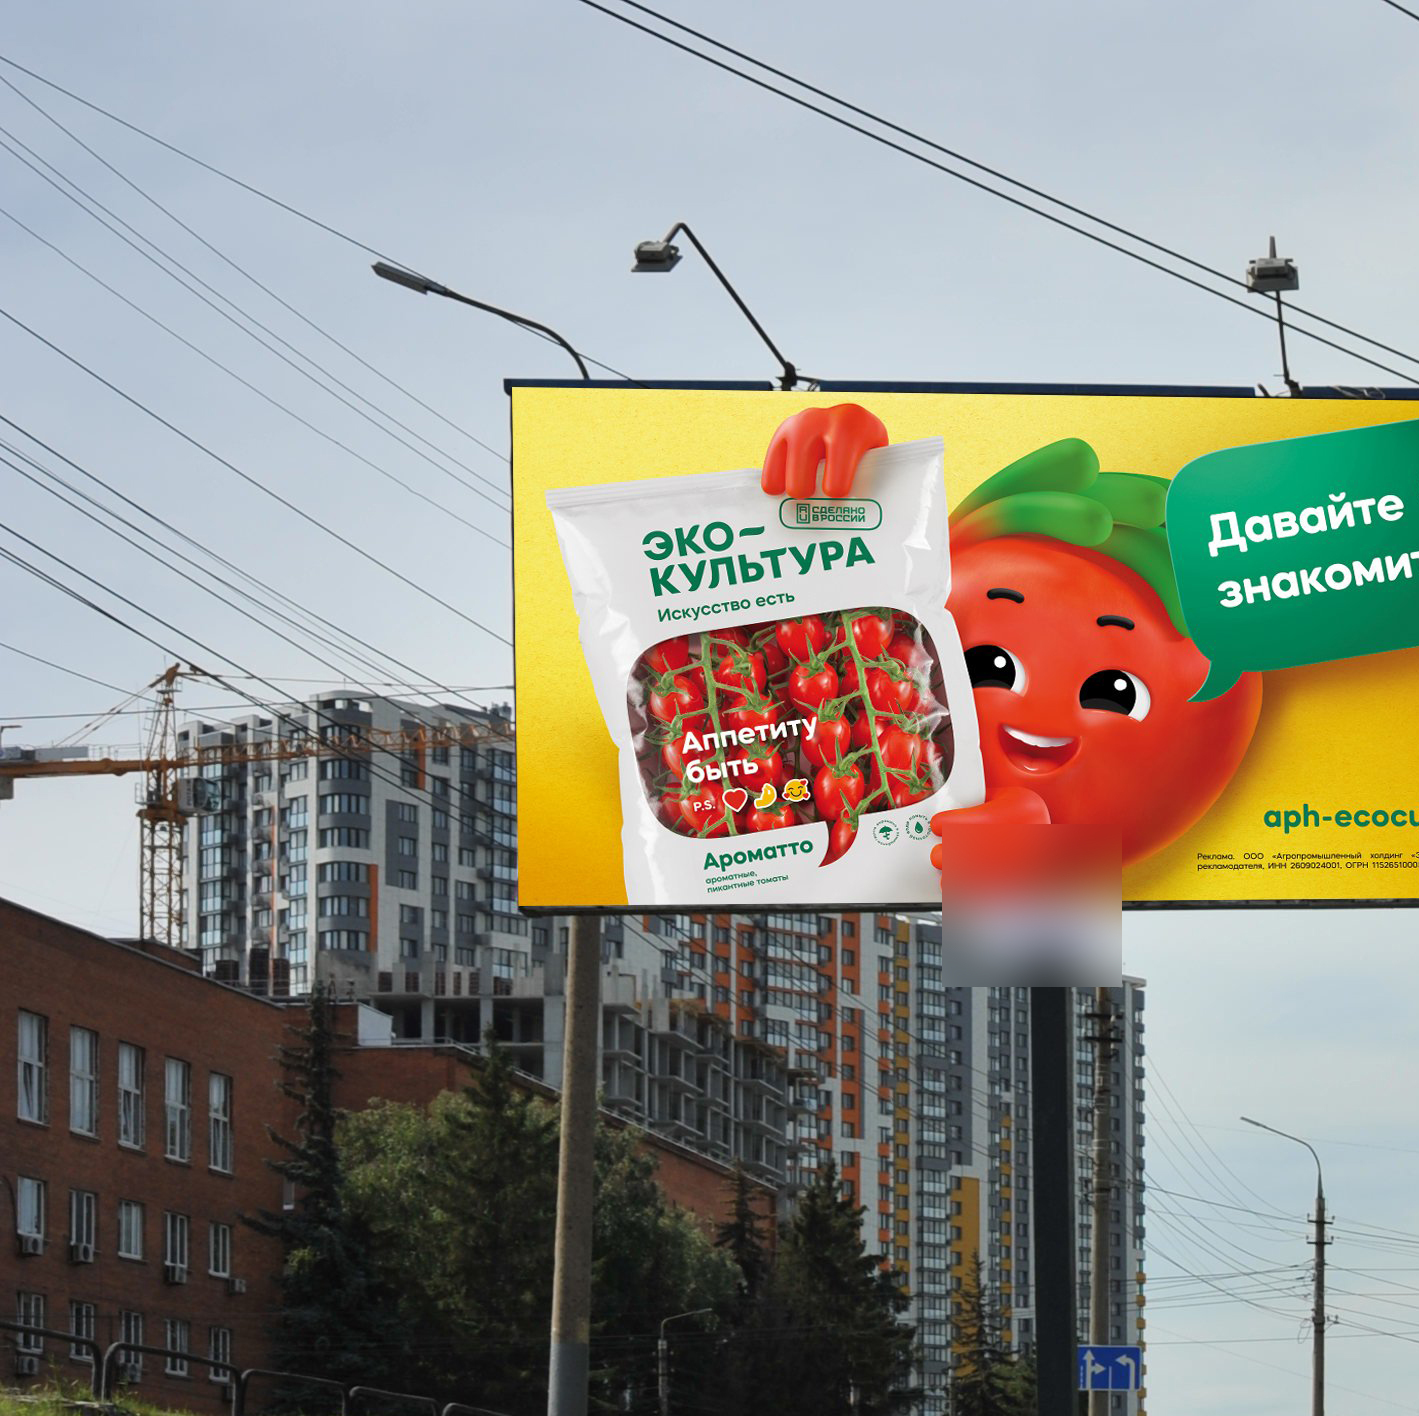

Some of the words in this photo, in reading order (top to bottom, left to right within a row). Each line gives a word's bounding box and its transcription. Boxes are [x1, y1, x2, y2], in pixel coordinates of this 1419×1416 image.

[812, 506, 866, 514] СДЕЛАНО
[1208, 492, 1405, 558] Давайте
[649, 536, 876, 597] КУЛЬТУРА
[657, 599, 751, 622] Искусство
[755, 592, 795, 607] есть
[682, 716, 817, 754] Аппетиту
[686, 758, 759, 783] быть
[693, 800, 716, 812] P.S.
[703, 840, 814, 872] Ароматто
[1197, 852, 1235, 860] Реклама.
[1243, 852, 1265, 860] ООО
[1272, 851, 1362, 862] «Агропромышленный
[1370, 851, 1403, 859] холдинг
[1197, 863, 1265, 871] рекламодателя,
[1346, 861, 1369, 869] ОГРН
[705, 870, 758, 886] ароматные,
[707, 879, 755, 893] пикантные
[756, 875, 789, 885] томаты
